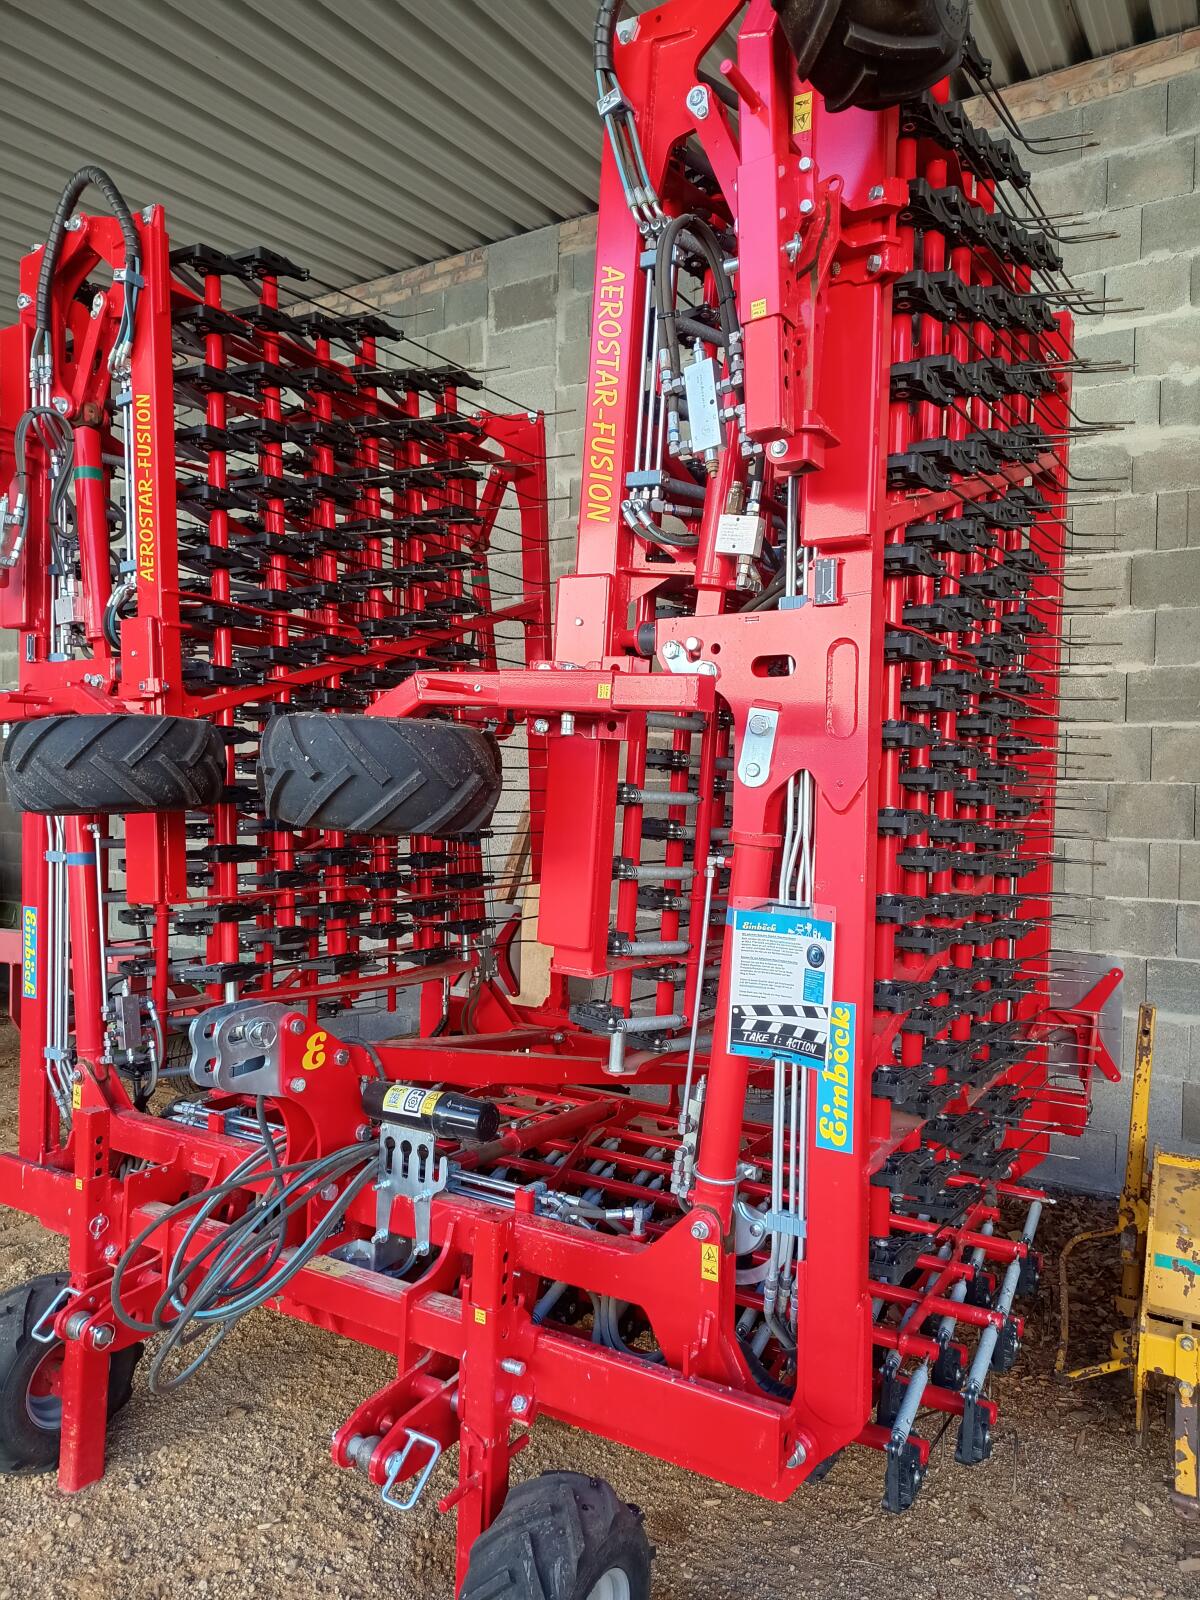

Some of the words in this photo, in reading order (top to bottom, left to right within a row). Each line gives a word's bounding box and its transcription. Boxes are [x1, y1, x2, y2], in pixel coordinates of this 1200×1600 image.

[587, 265, 626, 523] AEROSTAR-FUSION
[136, 394, 155, 582] AEROSTAR-FUSION
[25, 909, 37, 995] Einböck
[742, 921, 777, 932] Einböck
[742, 1031, 770, 1043] TAKE
[786, 1037, 818, 1053] ACTION
[819, 1007, 851, 1147] Einböck
